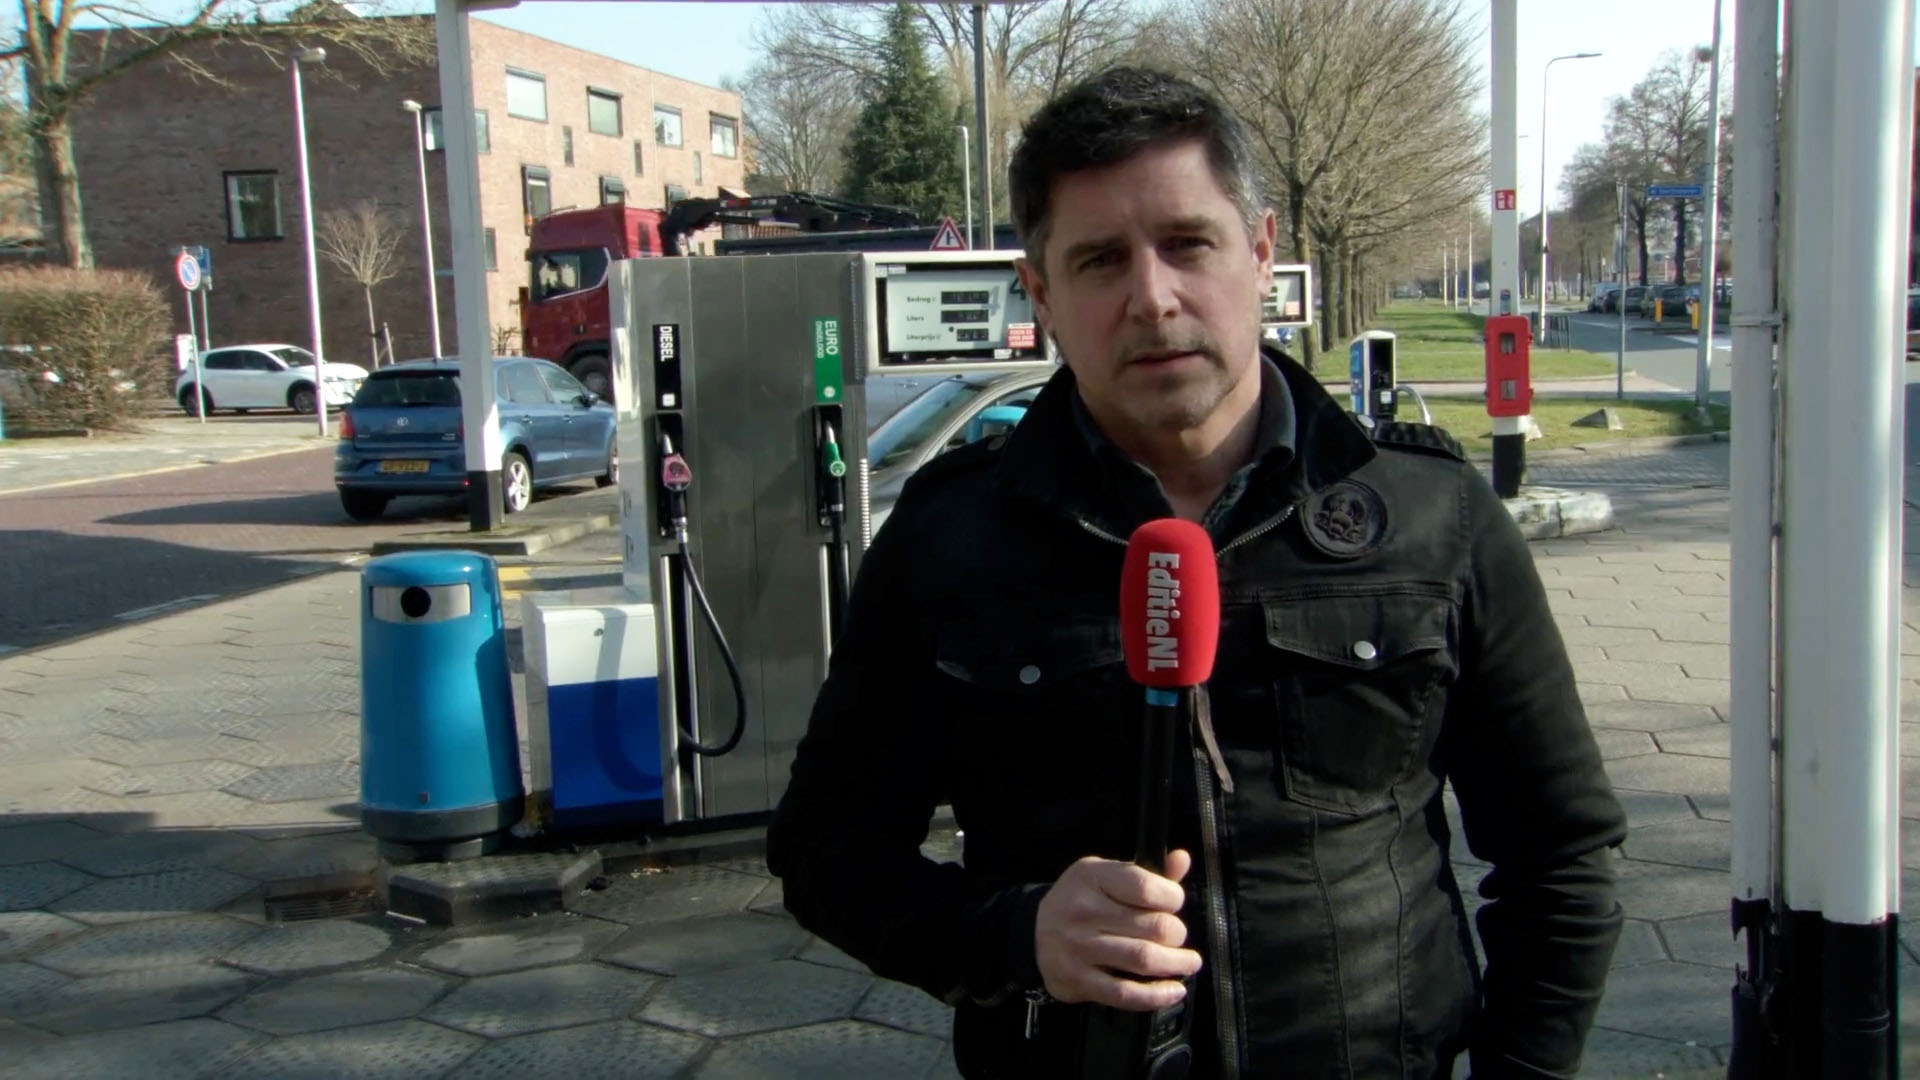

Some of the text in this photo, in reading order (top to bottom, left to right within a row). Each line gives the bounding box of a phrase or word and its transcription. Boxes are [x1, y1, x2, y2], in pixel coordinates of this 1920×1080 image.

[659, 325, 674, 362] DIESEL
[824, 320, 838, 355] EURO
[1146, 552, 1181, 672] EditieNL
